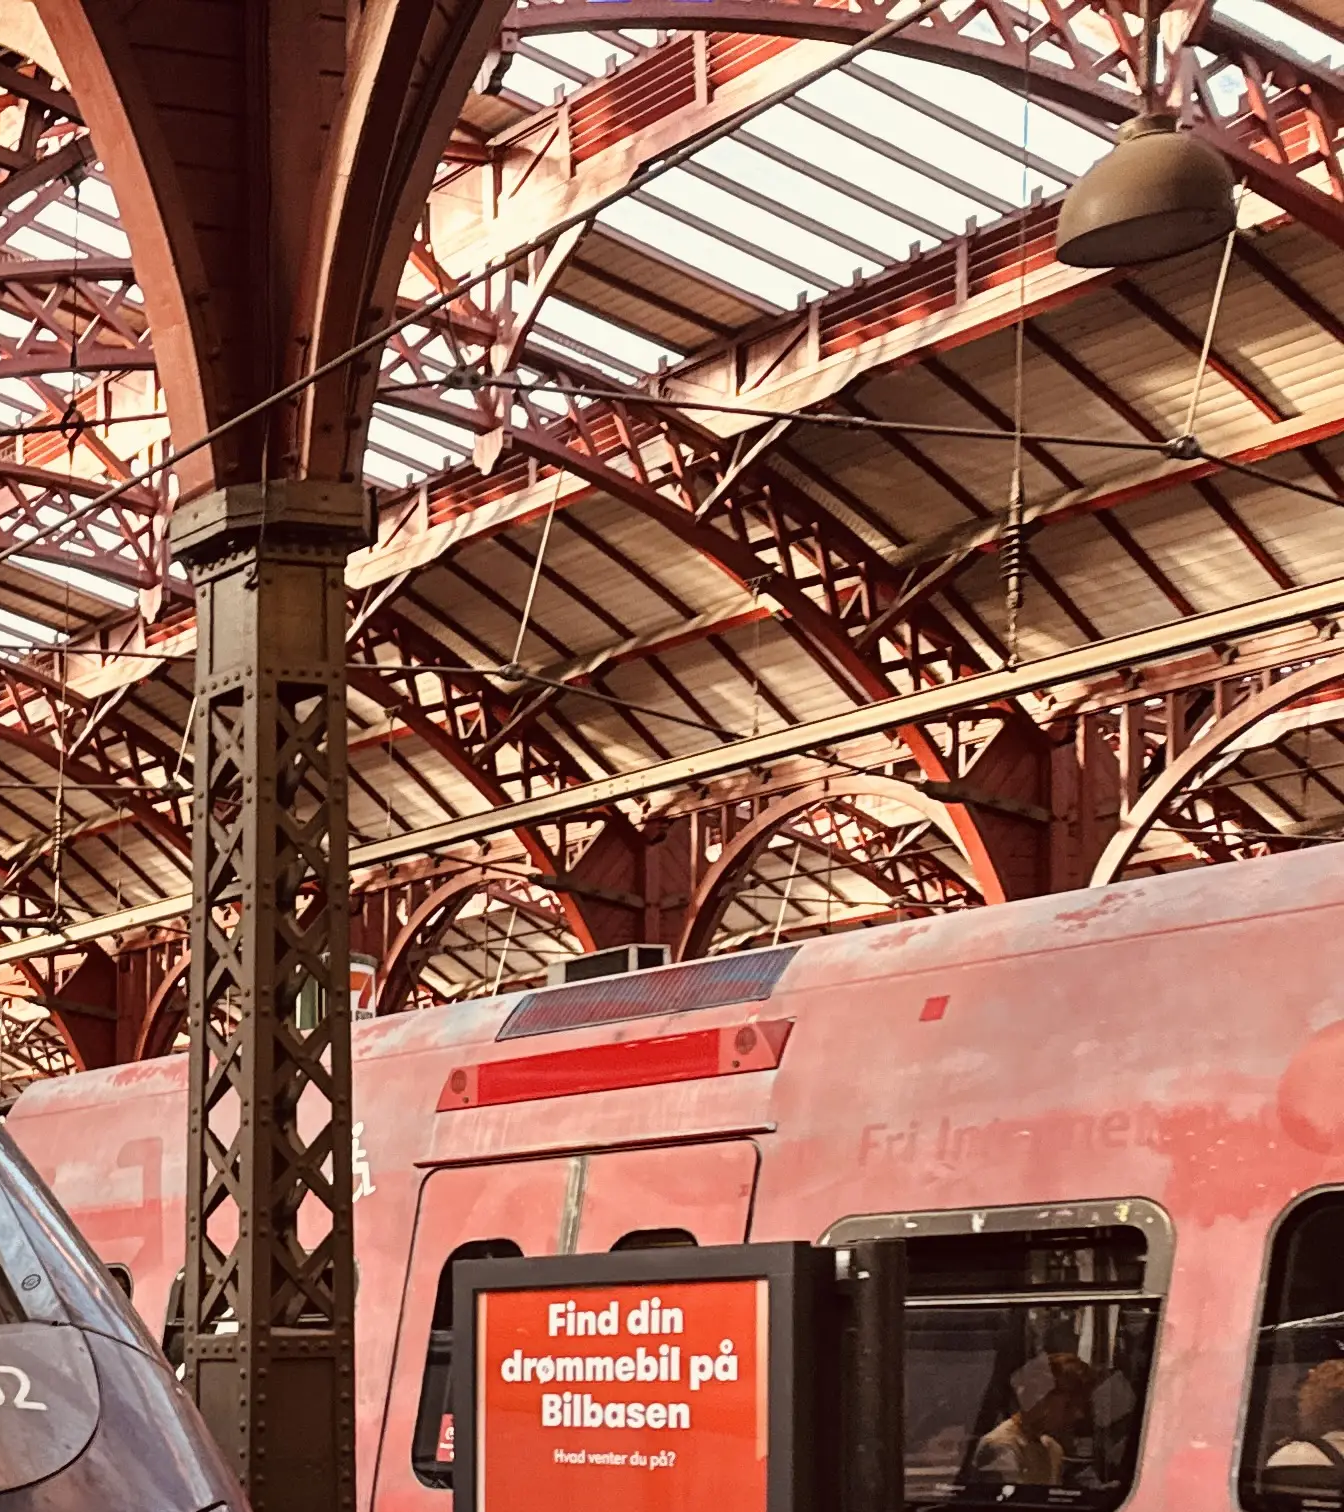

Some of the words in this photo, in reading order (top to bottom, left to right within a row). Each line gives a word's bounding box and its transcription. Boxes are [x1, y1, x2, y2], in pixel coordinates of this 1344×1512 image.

[547, 1299, 620, 1337] Find
[626, 1296, 684, 1335] din
[500, 1343, 681, 1384] drømmebil
[689, 1338, 739, 1391] på
[541, 1391, 691, 1430] Bilbasen
[553, 1448, 586, 1465] Hvad
[587, 1451, 628, 1466] venter
[629, 1451, 648, 1466] du
[649, 1450, 677, 1470] på?
